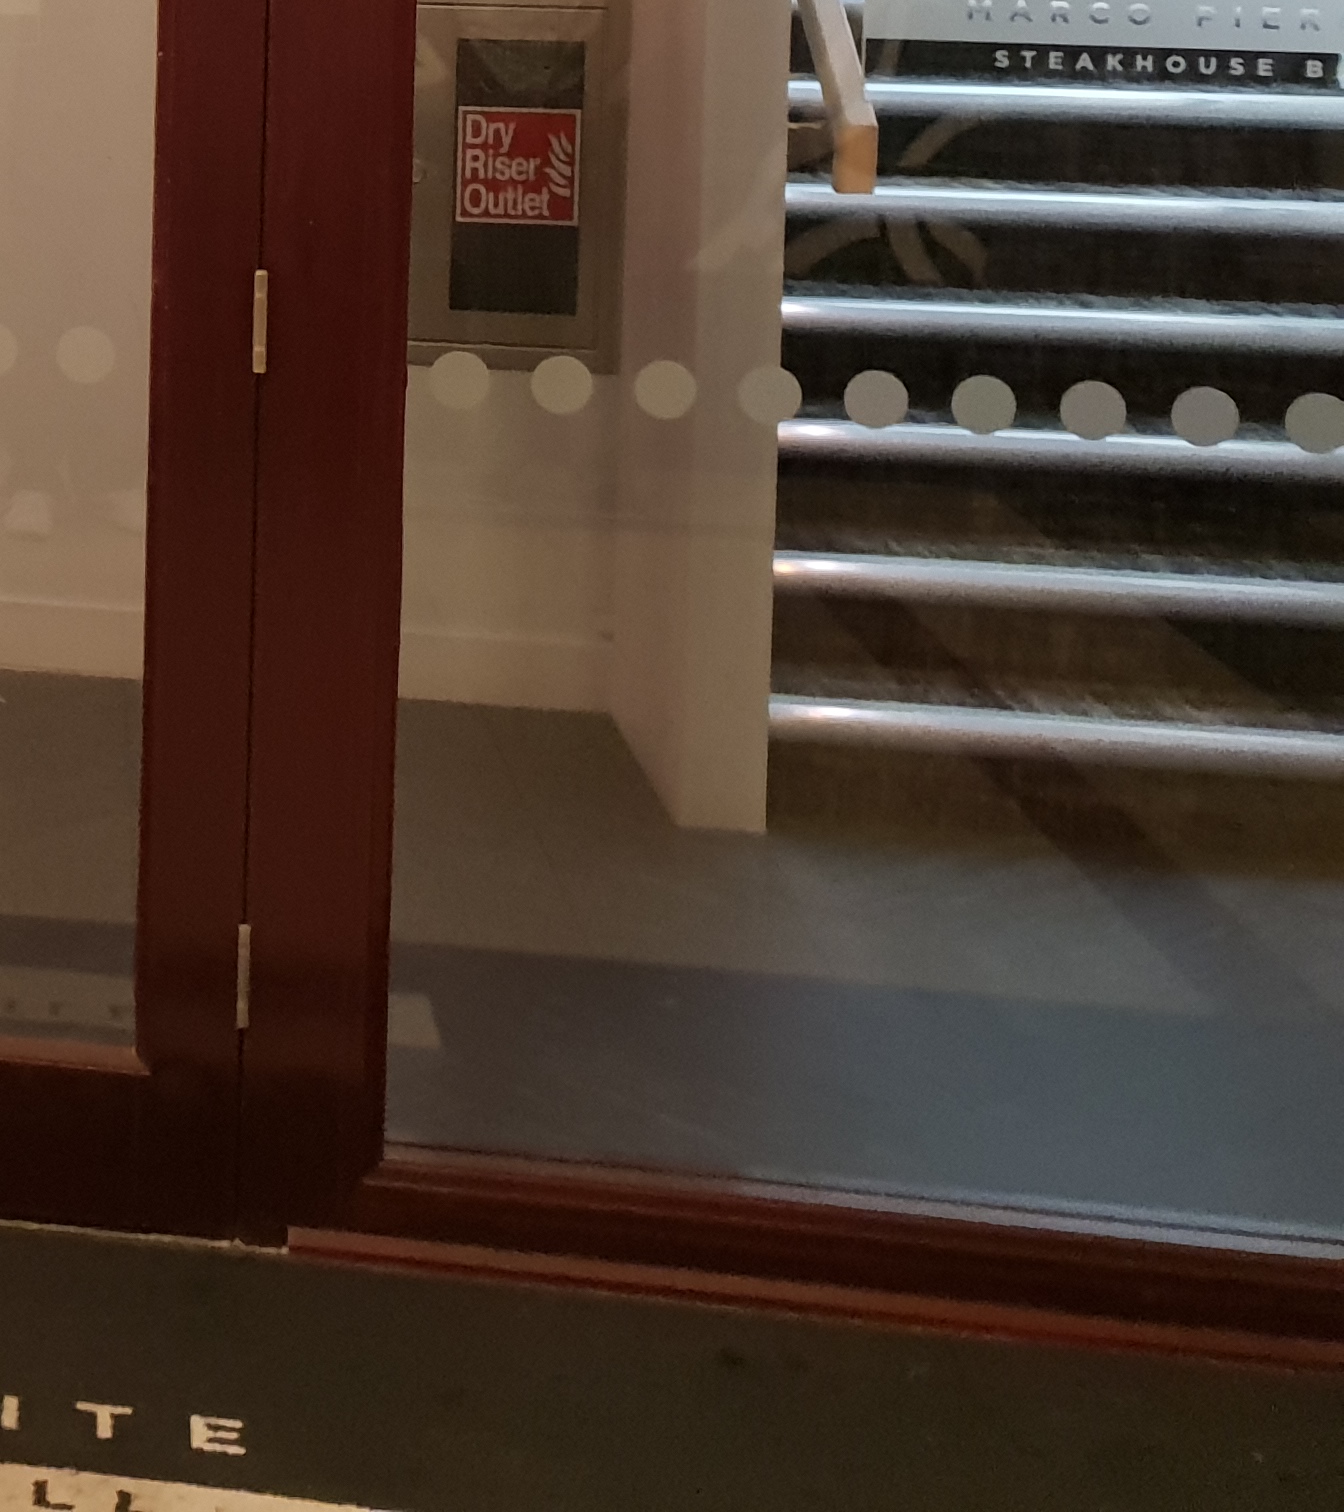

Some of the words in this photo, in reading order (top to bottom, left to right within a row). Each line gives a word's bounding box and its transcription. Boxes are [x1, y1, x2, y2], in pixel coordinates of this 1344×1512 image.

[1194, 3, 1322, 32] PIER
[993, 48, 1275, 78] STEAKHOUSE
[465, 113, 516, 154] Dry
[464, 148, 541, 181] Riser
[463, 183, 550, 217] Outlet
